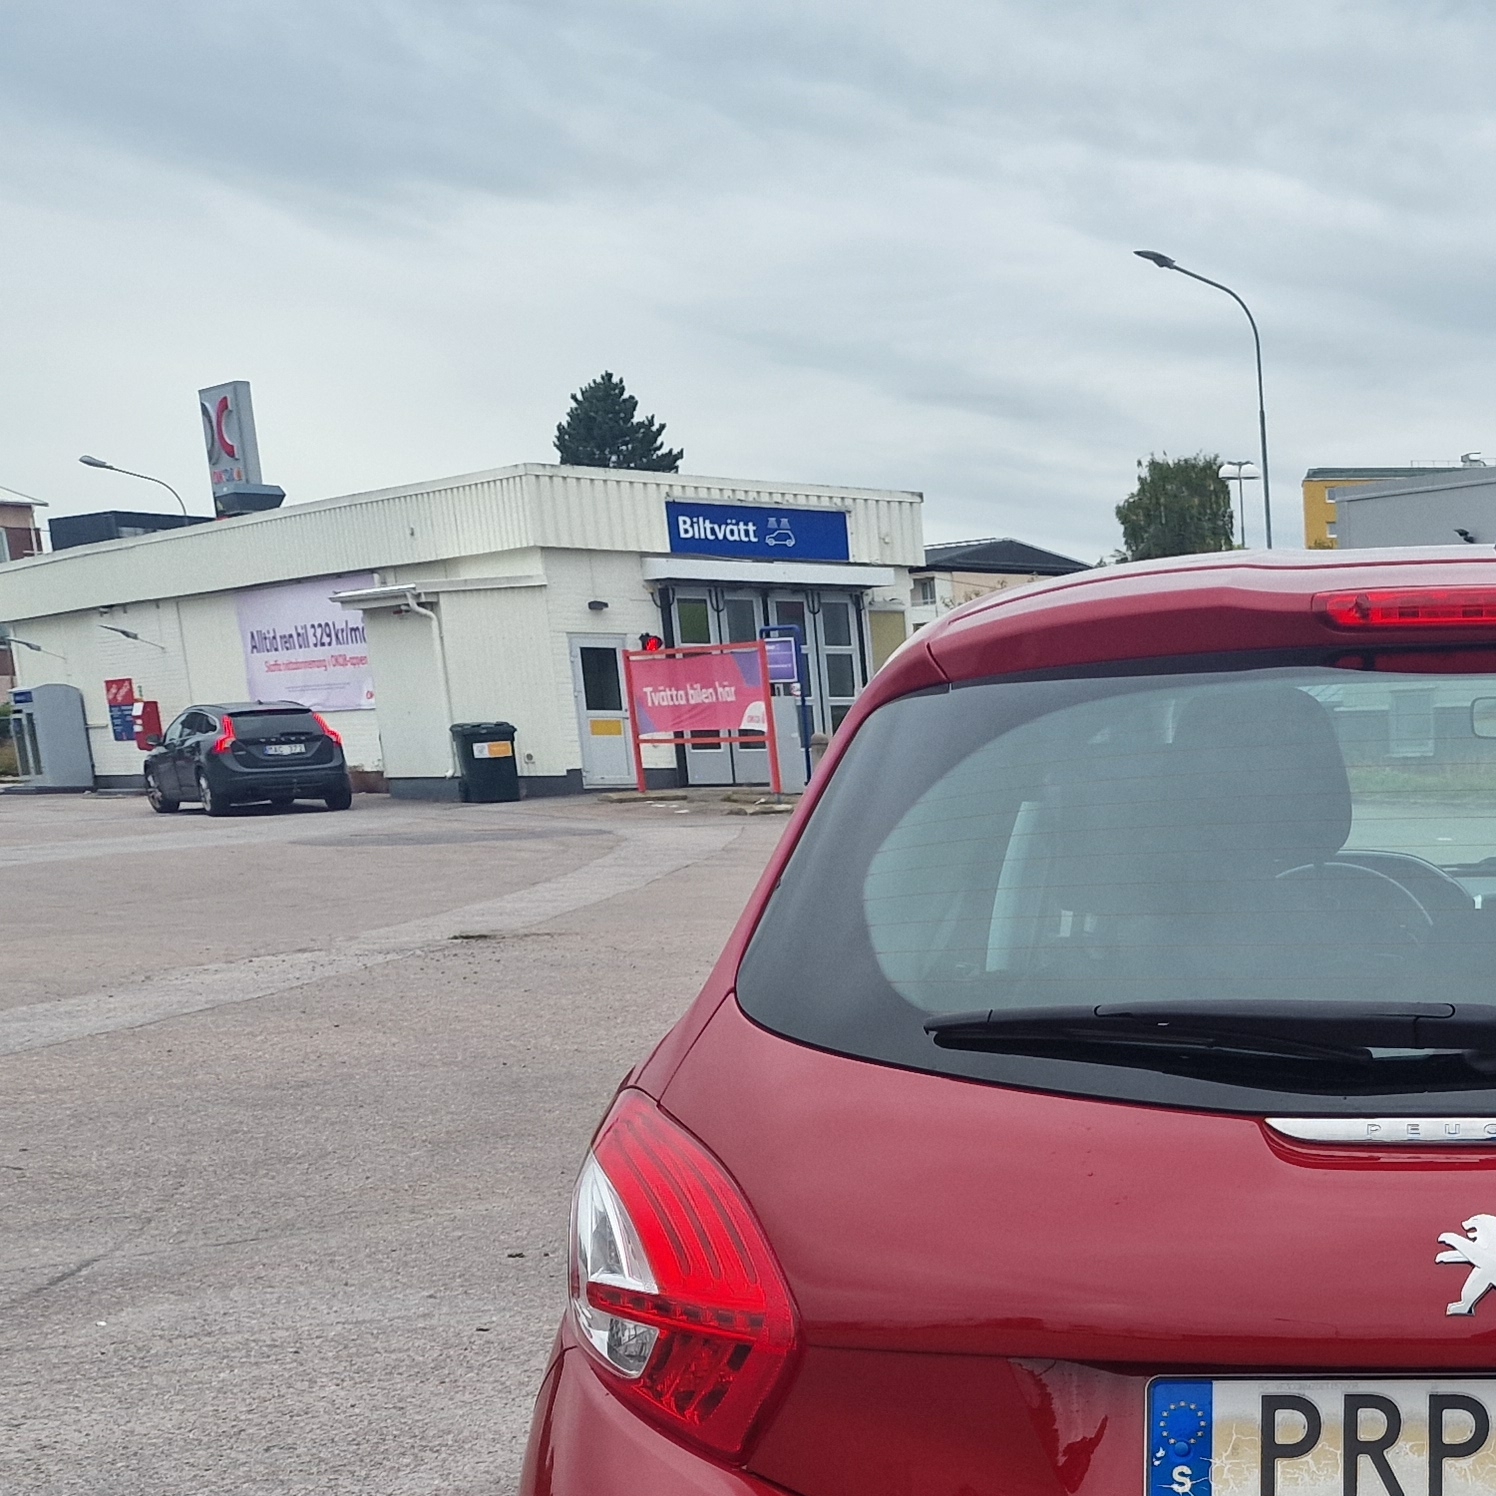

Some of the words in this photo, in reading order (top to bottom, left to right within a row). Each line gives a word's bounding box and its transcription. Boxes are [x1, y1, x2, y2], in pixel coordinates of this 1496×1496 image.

[678, 516, 759, 542] Biltvätt
[250, 628, 279, 654] Alltid
[279, 632, 297, 652] ren
[295, 623, 310, 650] bil
[310, 622, 333, 648] 329
[643, 685, 686, 707] Tvätta
[686, 682, 716, 704] bilen
[716, 681, 736, 703] här
[1172, 1465, 1192, 1493] S
